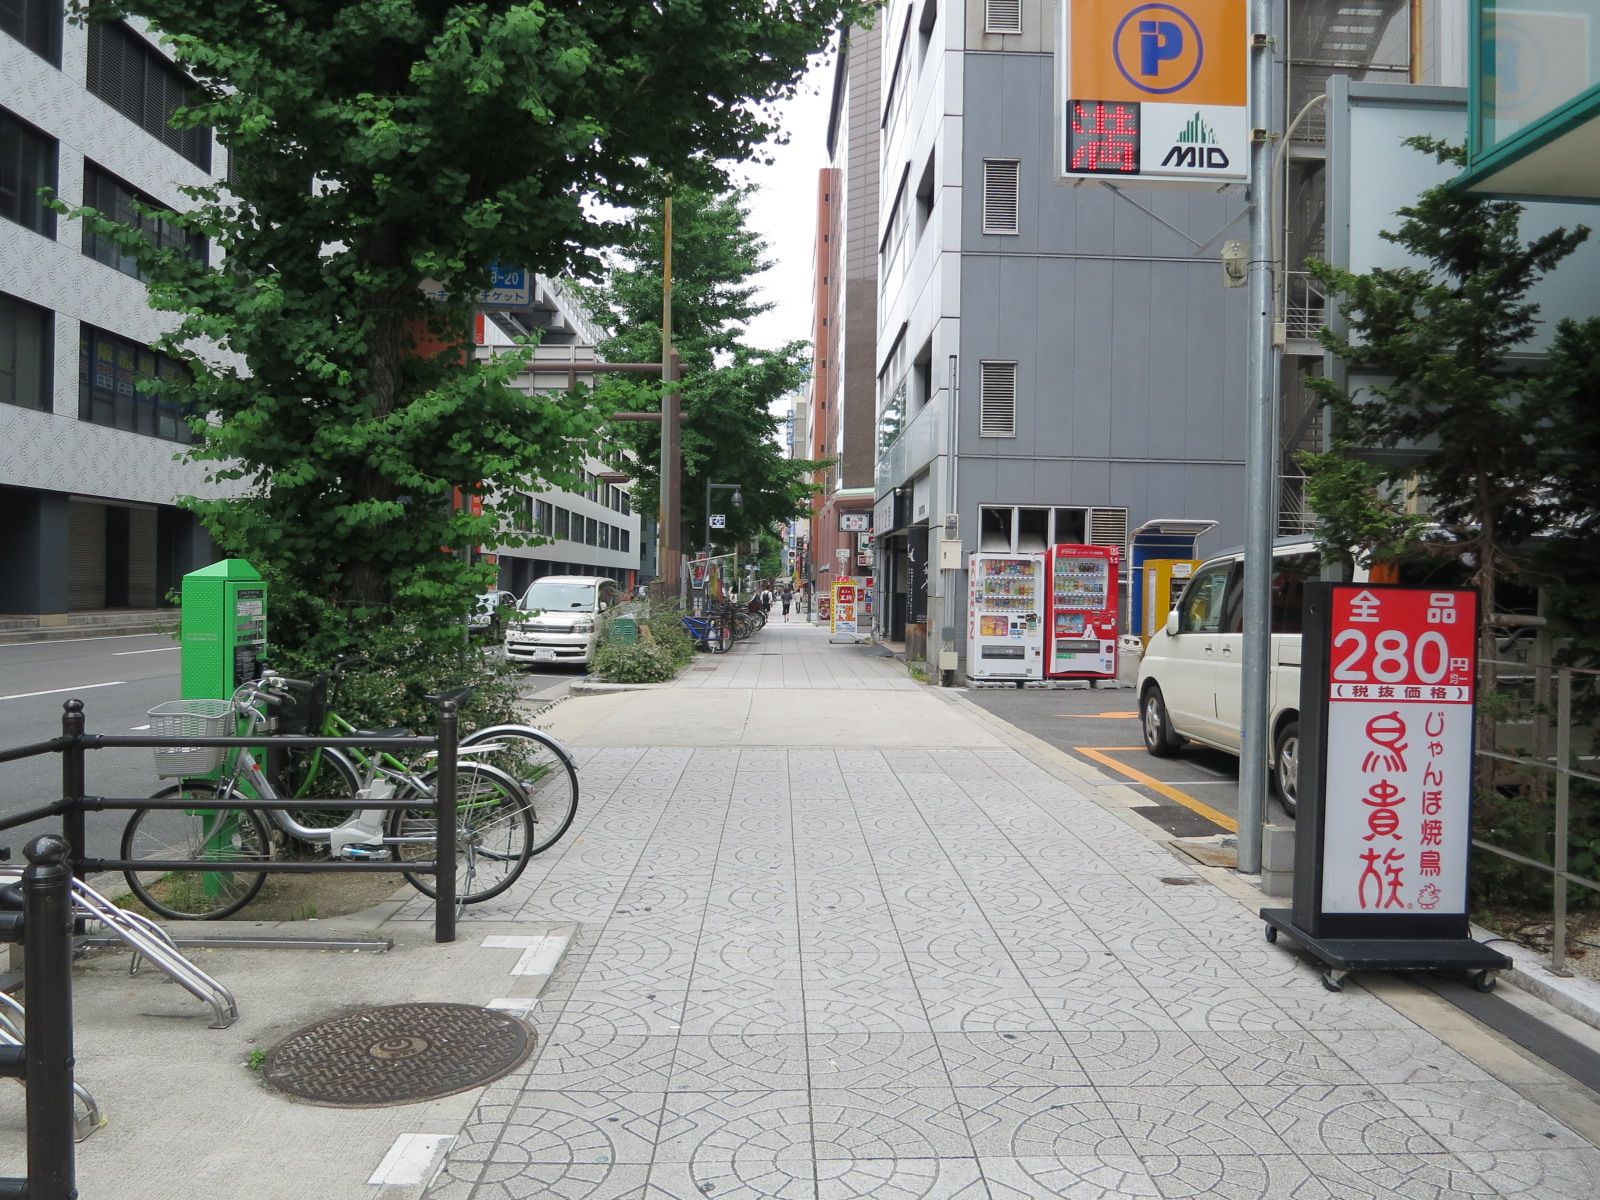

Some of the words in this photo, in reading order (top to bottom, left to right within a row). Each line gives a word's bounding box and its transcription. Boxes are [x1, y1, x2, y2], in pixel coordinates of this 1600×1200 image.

[1161, 145, 1230, 169] MID
[1349, 590, 1456, 624] 全品
[1358, 711, 1408, 909] 鳥貴族
[1419, 711, 1446, 877] じゃんぼ焼鳥
